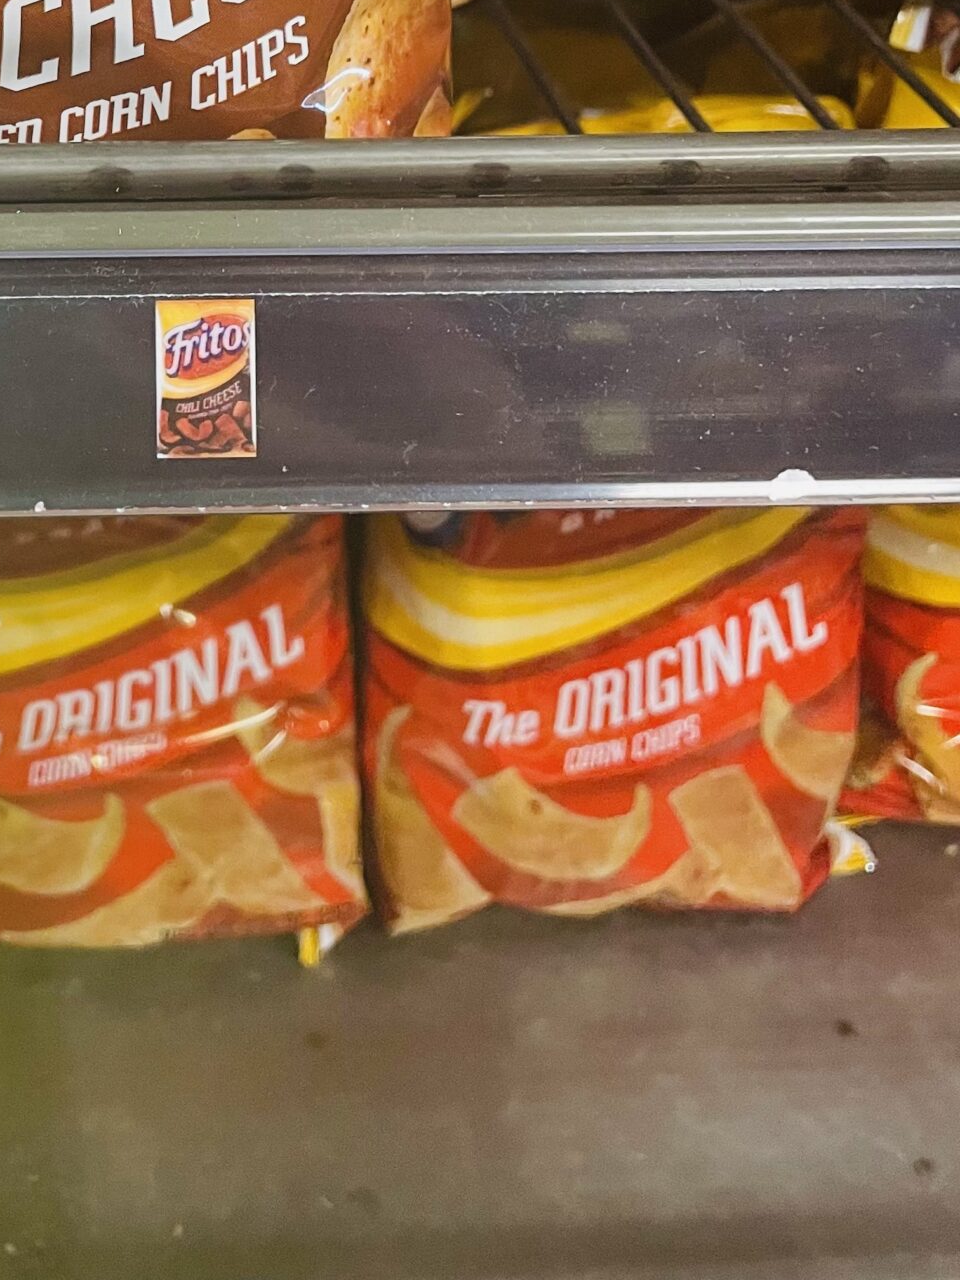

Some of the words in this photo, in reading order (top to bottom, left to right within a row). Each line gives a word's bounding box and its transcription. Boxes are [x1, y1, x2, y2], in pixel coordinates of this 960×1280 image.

[59, 81, 173, 144] CORN
[190, 15, 310, 113] CHIPS
[164, 318, 250, 377] Fritos
[175, 401, 200, 414] CHILI
[203, 380, 243, 410] CHEESE
[17, 604, 306, 752] ORIGINAL
[461, 699, 539, 748] The
[553, 581, 829, 739] ORIGINAL
